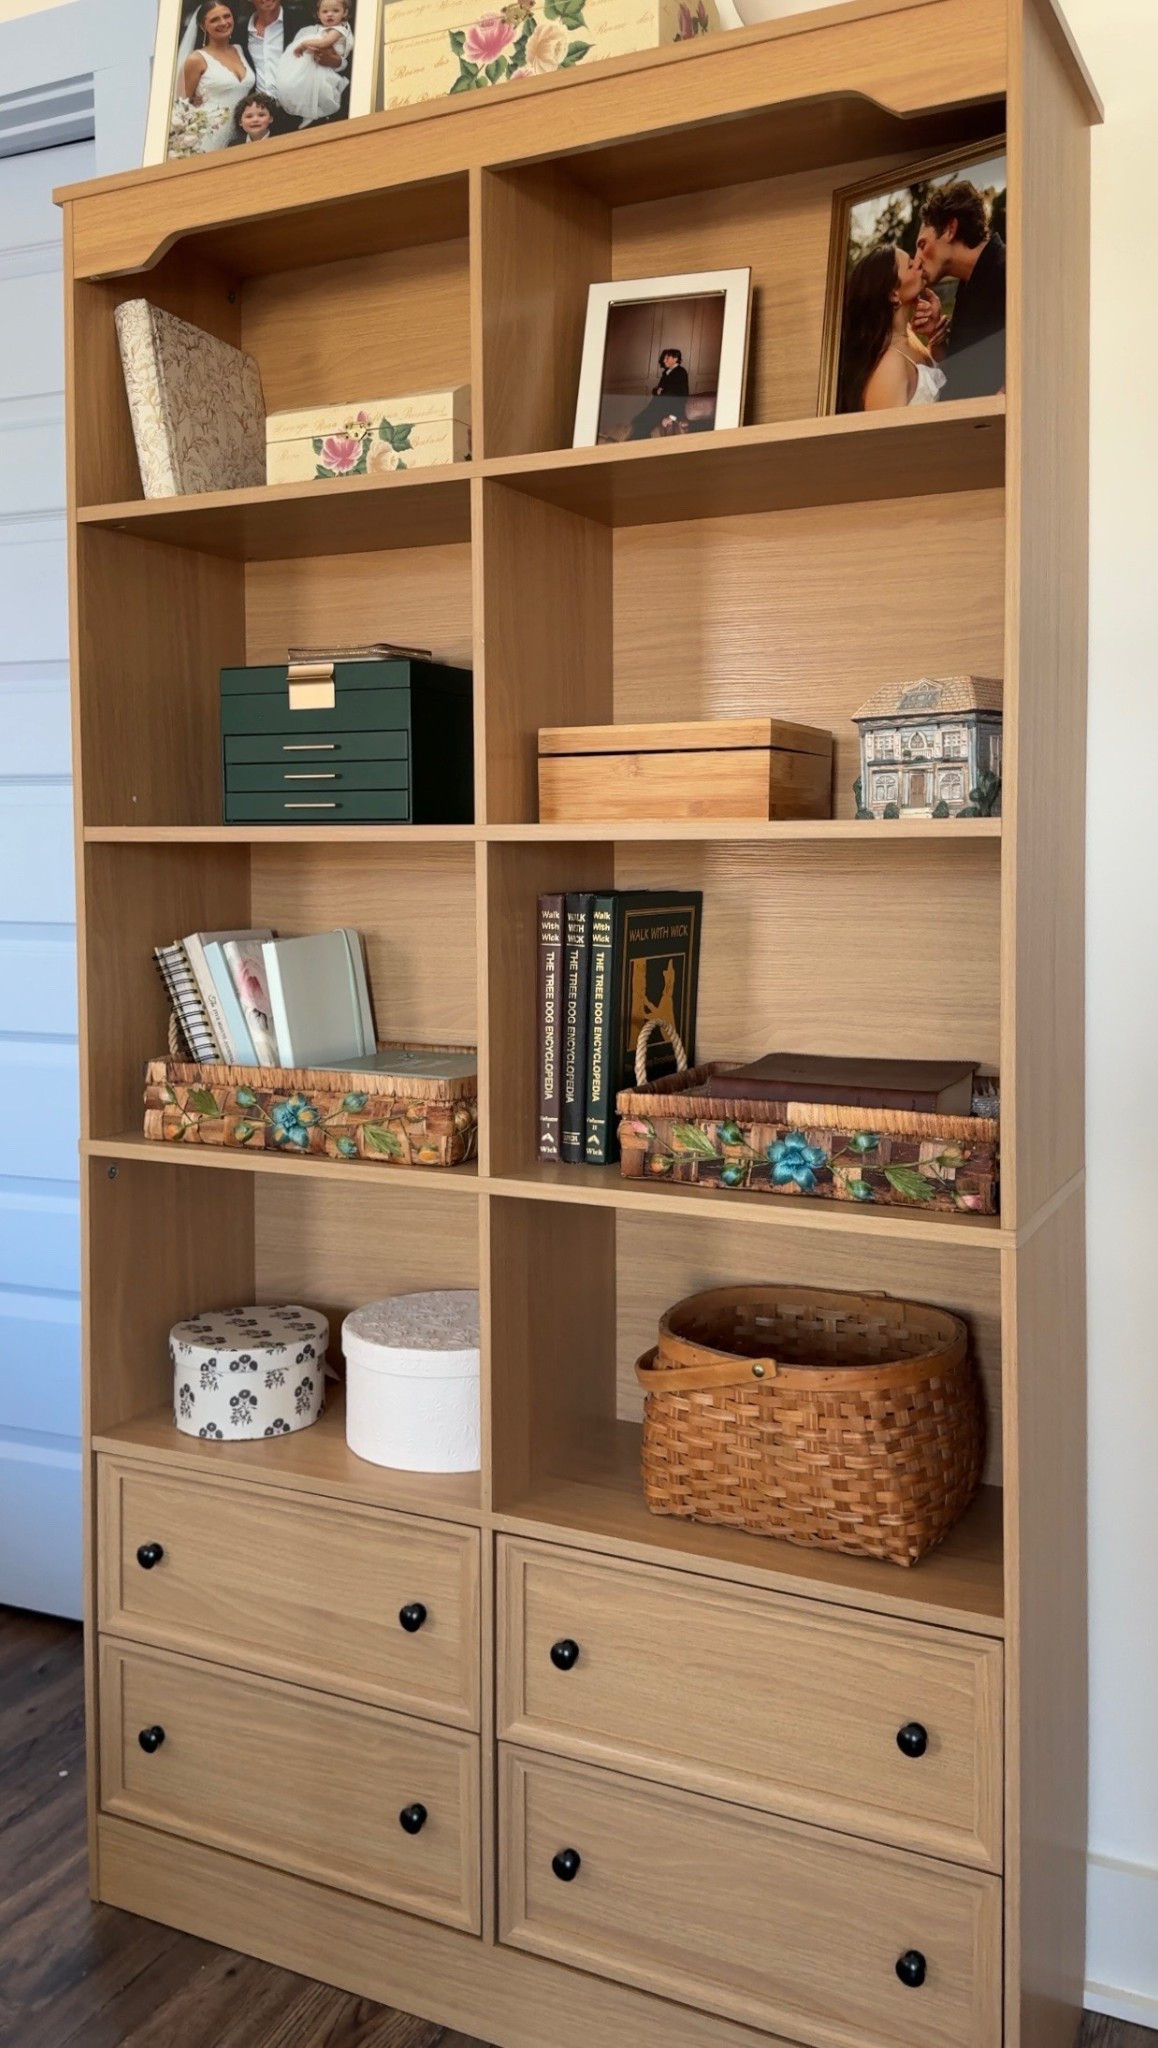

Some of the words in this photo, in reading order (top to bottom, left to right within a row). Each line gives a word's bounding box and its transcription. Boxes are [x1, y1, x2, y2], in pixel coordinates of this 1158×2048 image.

[541, 910, 560, 919] Walk
[567, 912, 586, 922] WALK
[592, 911, 611, 920] Walk
[541, 922, 560, 930] With
[567, 924, 585, 933] WITH
[592, 922, 611, 931] With
[629, 927, 649, 942] WALK
[650, 926, 669, 940] WITH
[670, 924, 688, 938] WICK
[541, 933, 560, 942] Wick
[567, 935, 585, 944] WICK
[592, 934, 611, 943] Wick
[546, 951, 555, 971] THE
[569, 950, 579, 970] THE
[595, 951, 604, 972] THE
[545, 973, 555, 999] TREE
[568, 972, 578, 999] TREE
[594, 974, 604, 1000] TREE
[545, 1001, 554, 1023] DOG
[567, 1001, 577, 1024] DOG
[594, 1002, 603, 1024] DOG
[544, 1025, 554, 1100] ENCYCLOPEDIA
[565, 1026, 576, 1103] ENCYCLOPEDIA
[591, 1026, 602, 1102] ENCYCLOPEDIA
[539, 1145, 558, 1154] Wick
[586, 1147, 603, 1156] Wick
